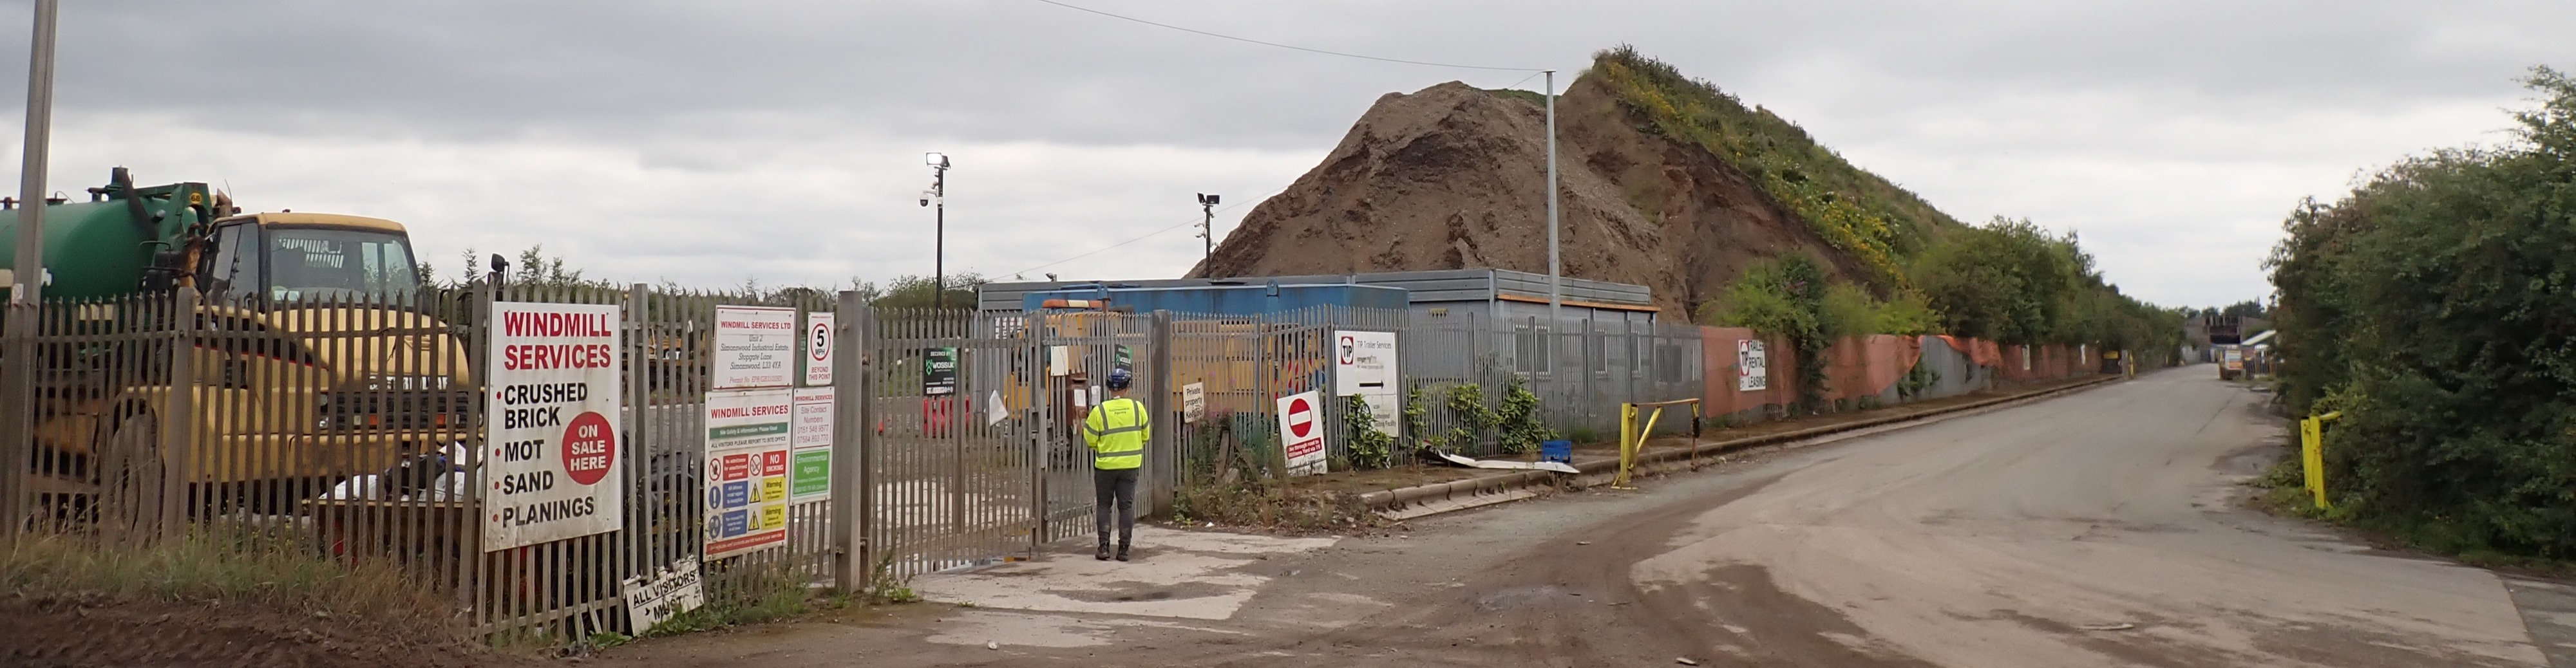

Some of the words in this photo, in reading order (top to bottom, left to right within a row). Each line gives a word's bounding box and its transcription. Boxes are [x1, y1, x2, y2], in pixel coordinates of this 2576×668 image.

[504, 311, 611, 337] WINDMILL
[817, 329, 824, 347] 5
[504, 344, 611, 370] SERVICES
[1342, 345, 1352, 358] TIP
[1748, 357, 1765, 368] RENTAL
[1748, 376, 1765, 387] LEASING
[504, 382, 588, 405] CRUSHED
[1186, 387, 1200, 396] Private
[1185, 397, 1202, 408] property
[505, 406, 560, 429] BRICK
[711, 407, 750, 419] WINDMILL
[752, 405, 788, 416] SERVICES
[578, 425, 598, 438] ON
[505, 440, 544, 462] MOT
[571, 440, 605, 455] SALE
[571, 456, 606, 471] HERE
[770, 454, 779, 464] NO
[803, 466, 820, 475] Agency
[503, 470, 554, 495] SAND
[503, 496, 594, 528] PLANINGS
[633, 589, 651, 606] ALL
[652, 570, 696, 597] VISITORS
